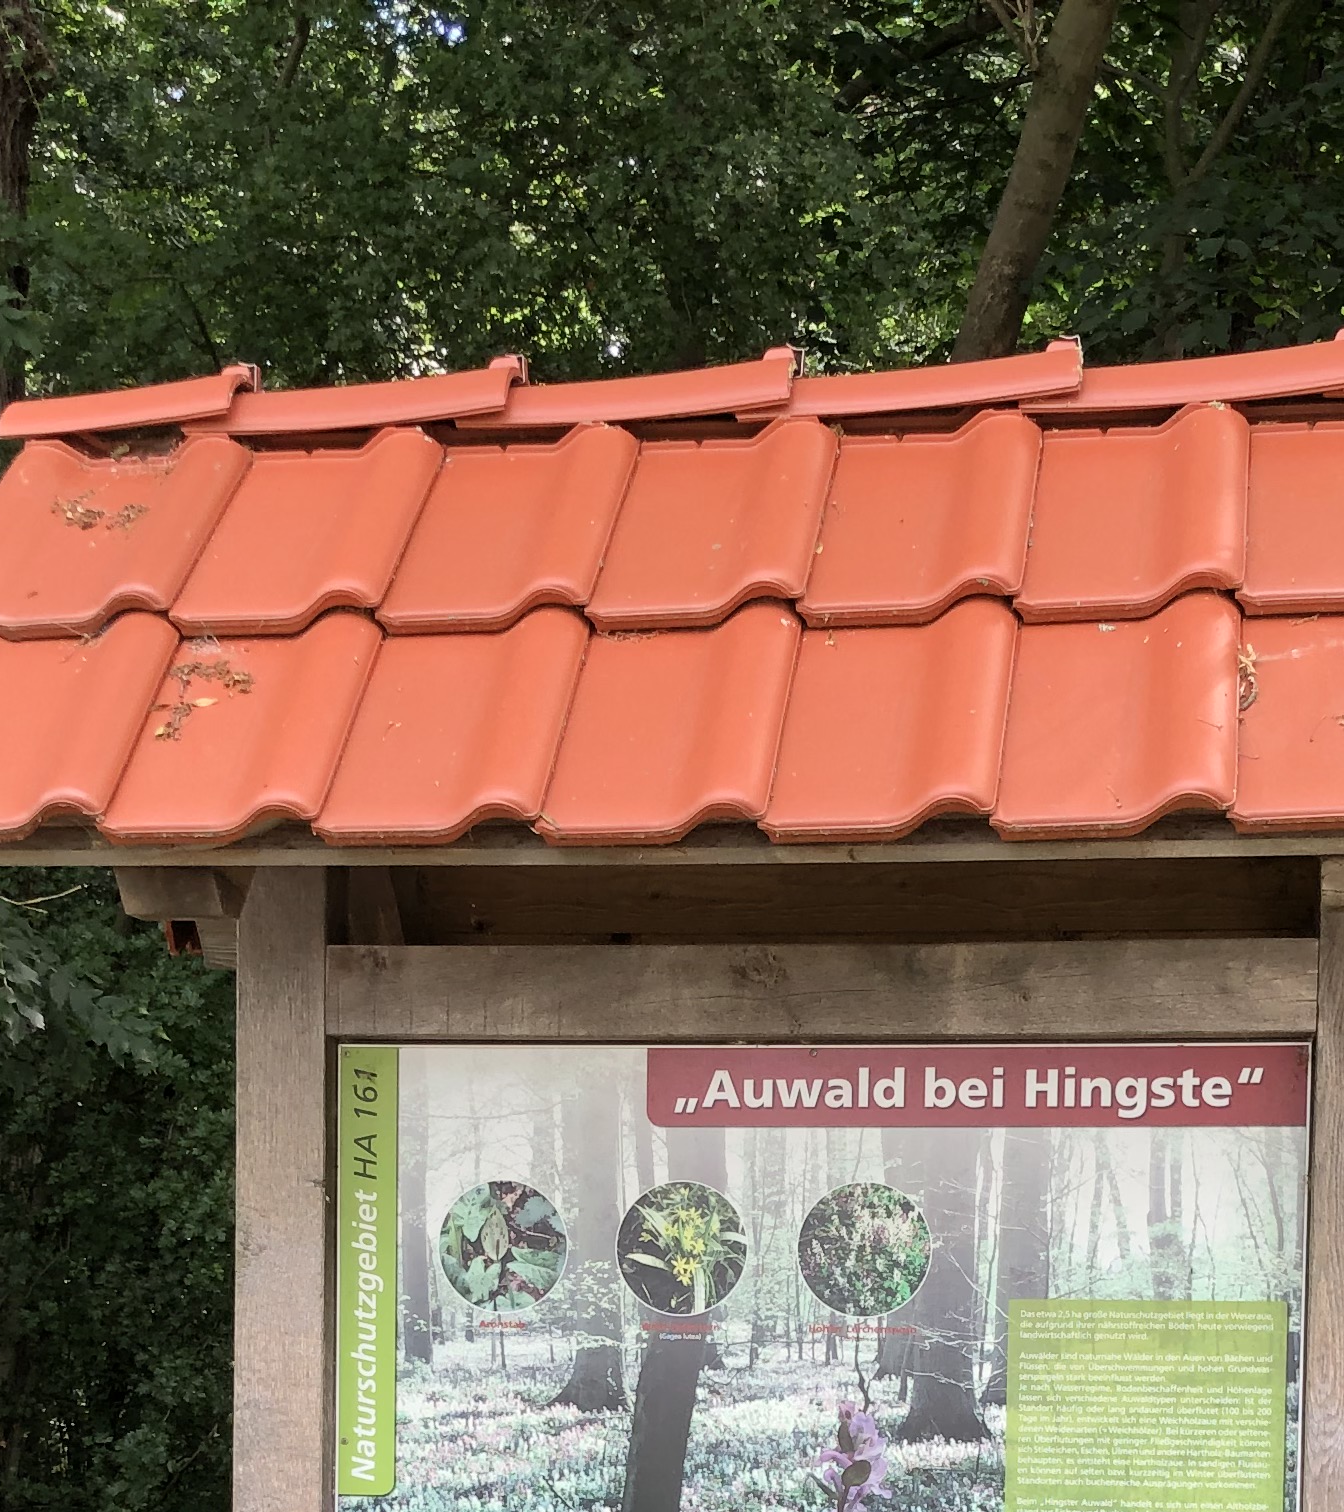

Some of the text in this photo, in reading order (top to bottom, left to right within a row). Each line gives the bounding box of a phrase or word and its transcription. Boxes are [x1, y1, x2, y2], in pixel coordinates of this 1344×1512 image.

[673, 1066, 1264, 1118] „Auwald bei Hingste“
[350, 1067, 384, 1481] Naturschutzgebiet HA 161
